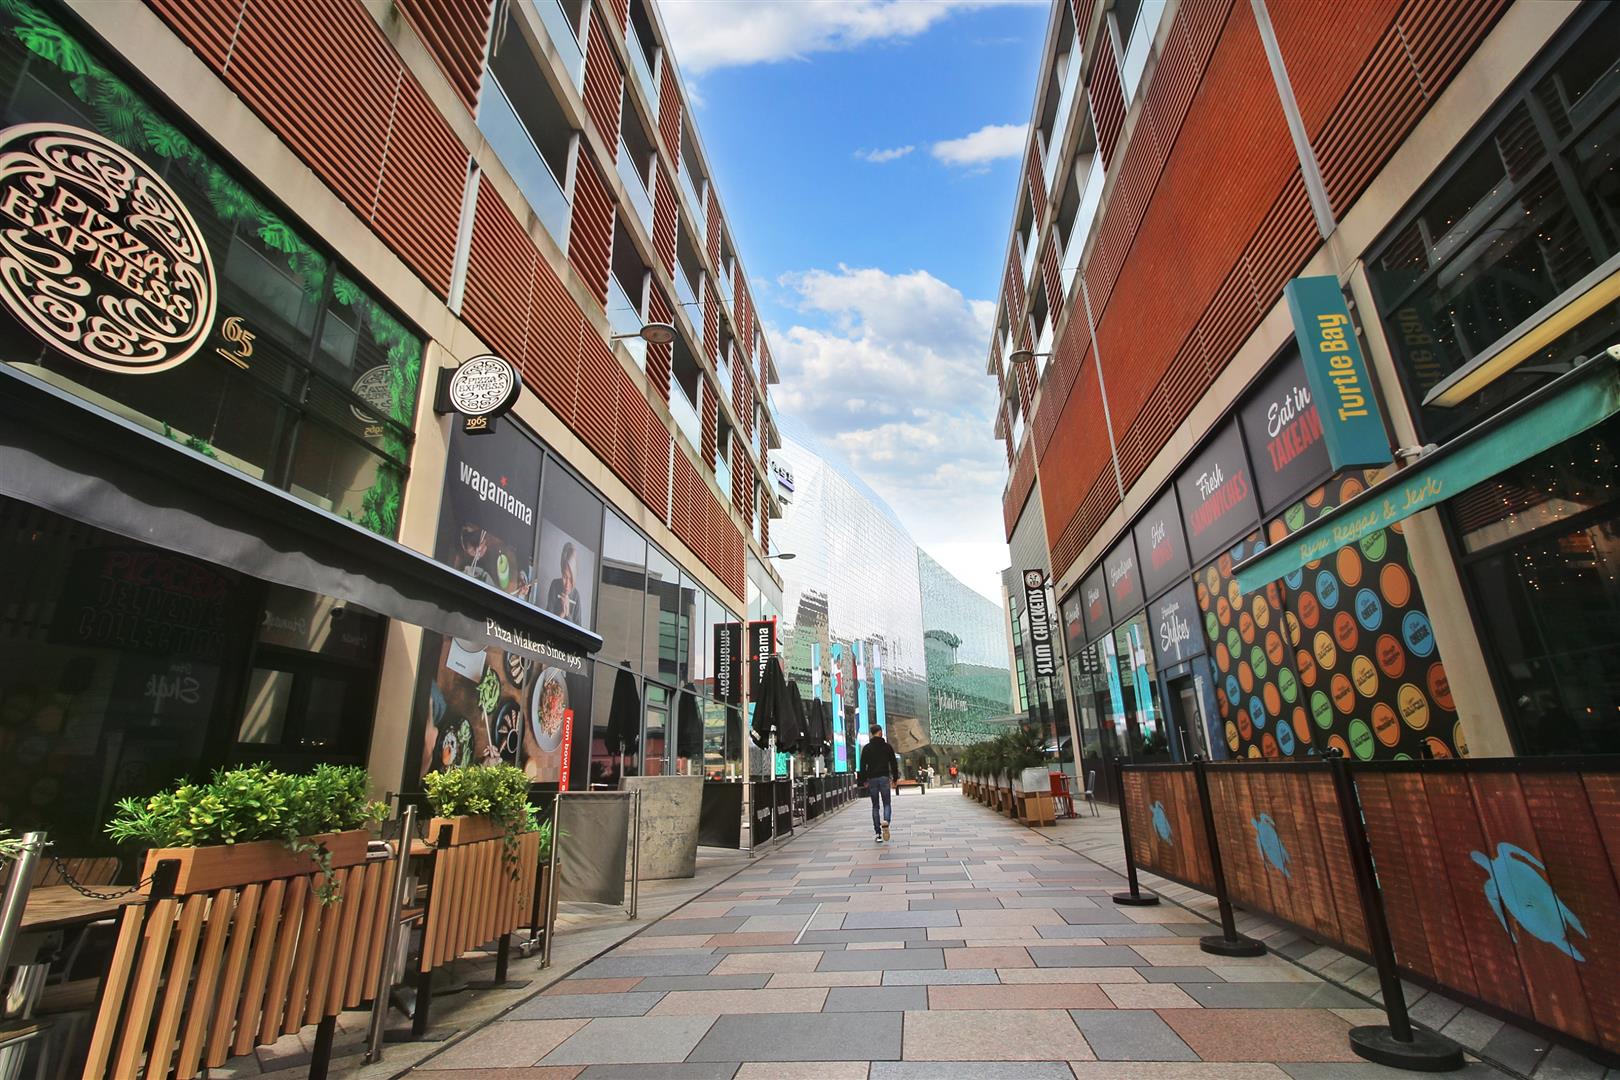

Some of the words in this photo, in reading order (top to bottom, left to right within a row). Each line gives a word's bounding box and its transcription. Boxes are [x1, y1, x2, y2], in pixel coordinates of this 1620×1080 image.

[1, 186, 192, 324] EXPRESS
[51, 186, 169, 283] PIZZA
[1317, 314, 1348, 353] Bay
[458, 382, 504, 393] EXPRESS
[467, 374, 497, 386] PIZZA
[1328, 355, 1368, 421] Turtle
[466, 417, 487, 428] 1965
[1268, 394, 1294, 437] Eat
[1292, 386, 1310, 411] in
[460, 461, 532, 526] wagamama
[1196, 464, 1224, 500] Fresh
[1299, 538, 1329, 560] Rum
[1332, 512, 1378, 543] Reggae
[1384, 499, 1396, 519] &
[1403, 477, 1443, 509] Jerk
[1028, 589, 1049, 640] CHICKENS
[1160, 616, 1190, 653] Shakes
[486, 617, 512, 643] Pizza
[513, 628, 545, 655] Makers
[546, 640, 566, 661] Since
[759, 628, 769, 683] amama
[1035, 644, 1053, 674] SLIM
[562, 771, 568, 783] to
